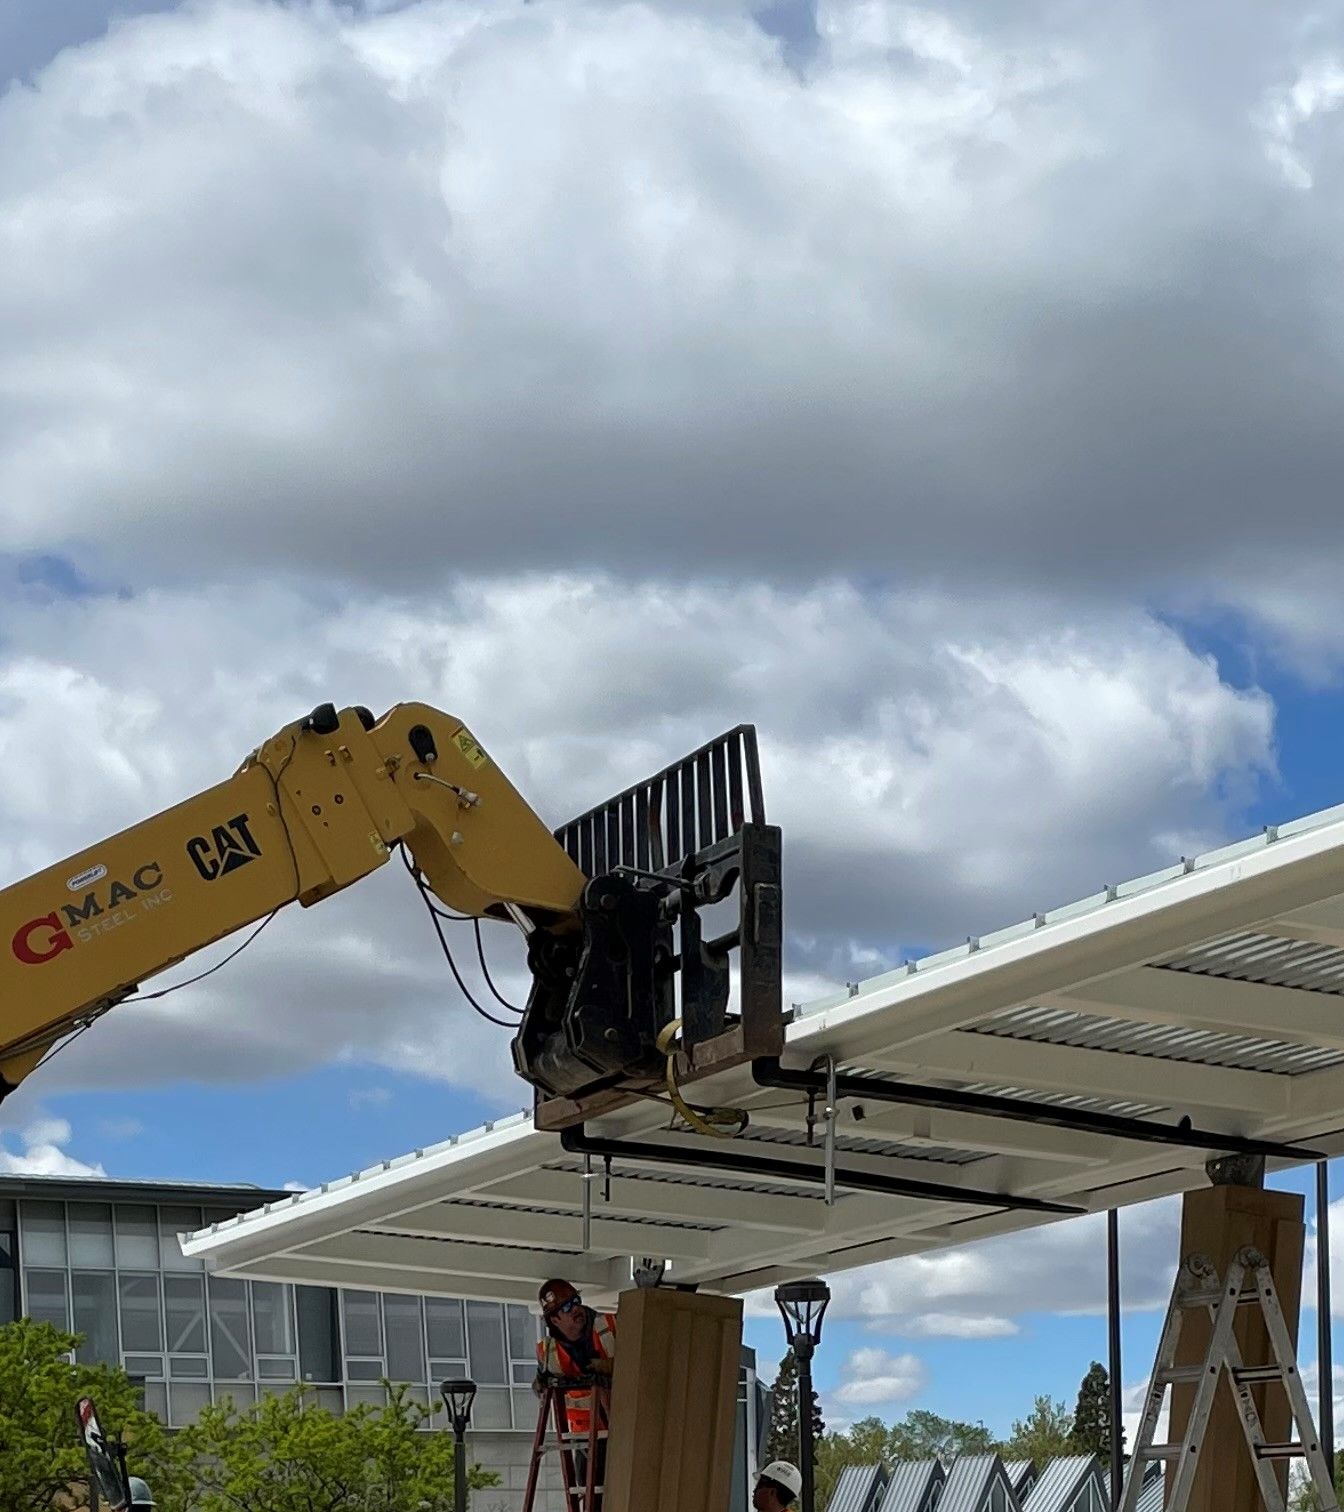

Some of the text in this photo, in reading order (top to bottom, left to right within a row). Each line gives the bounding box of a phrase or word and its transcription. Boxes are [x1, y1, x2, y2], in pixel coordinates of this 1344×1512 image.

[186, 813, 262, 881] CAT
[77, 887, 175, 943] STEEL INC
